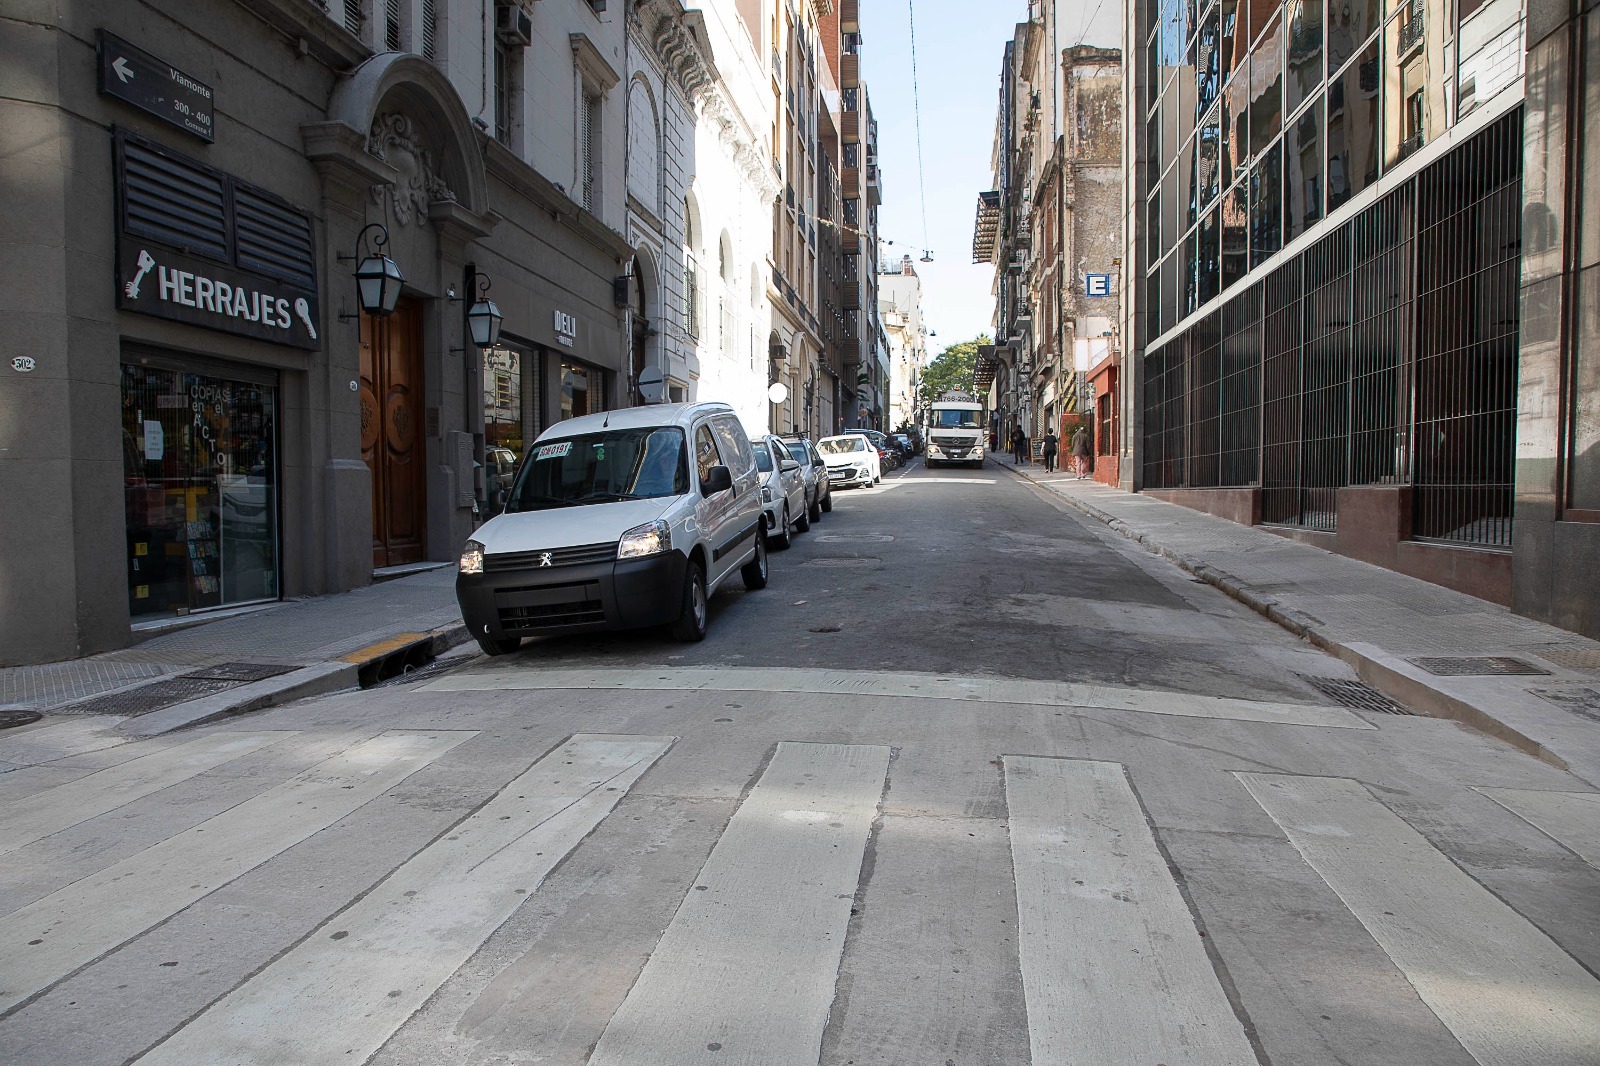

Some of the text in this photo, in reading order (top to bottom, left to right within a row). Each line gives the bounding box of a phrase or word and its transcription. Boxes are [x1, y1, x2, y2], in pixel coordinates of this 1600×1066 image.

[170, 68, 211, 99] Viamonte
[174, 99, 190, 116] 300
[196, 111, 211, 126] 400
[158, 265, 291, 329] HERRAJES
[1089, 276, 1106, 295] E
[554, 310, 576, 338] DELI
[15, 358, 31, 369] 302
[190, 385, 228, 403] COPIAS
[192, 401, 204, 412] en
[215, 400, 224, 415] el
